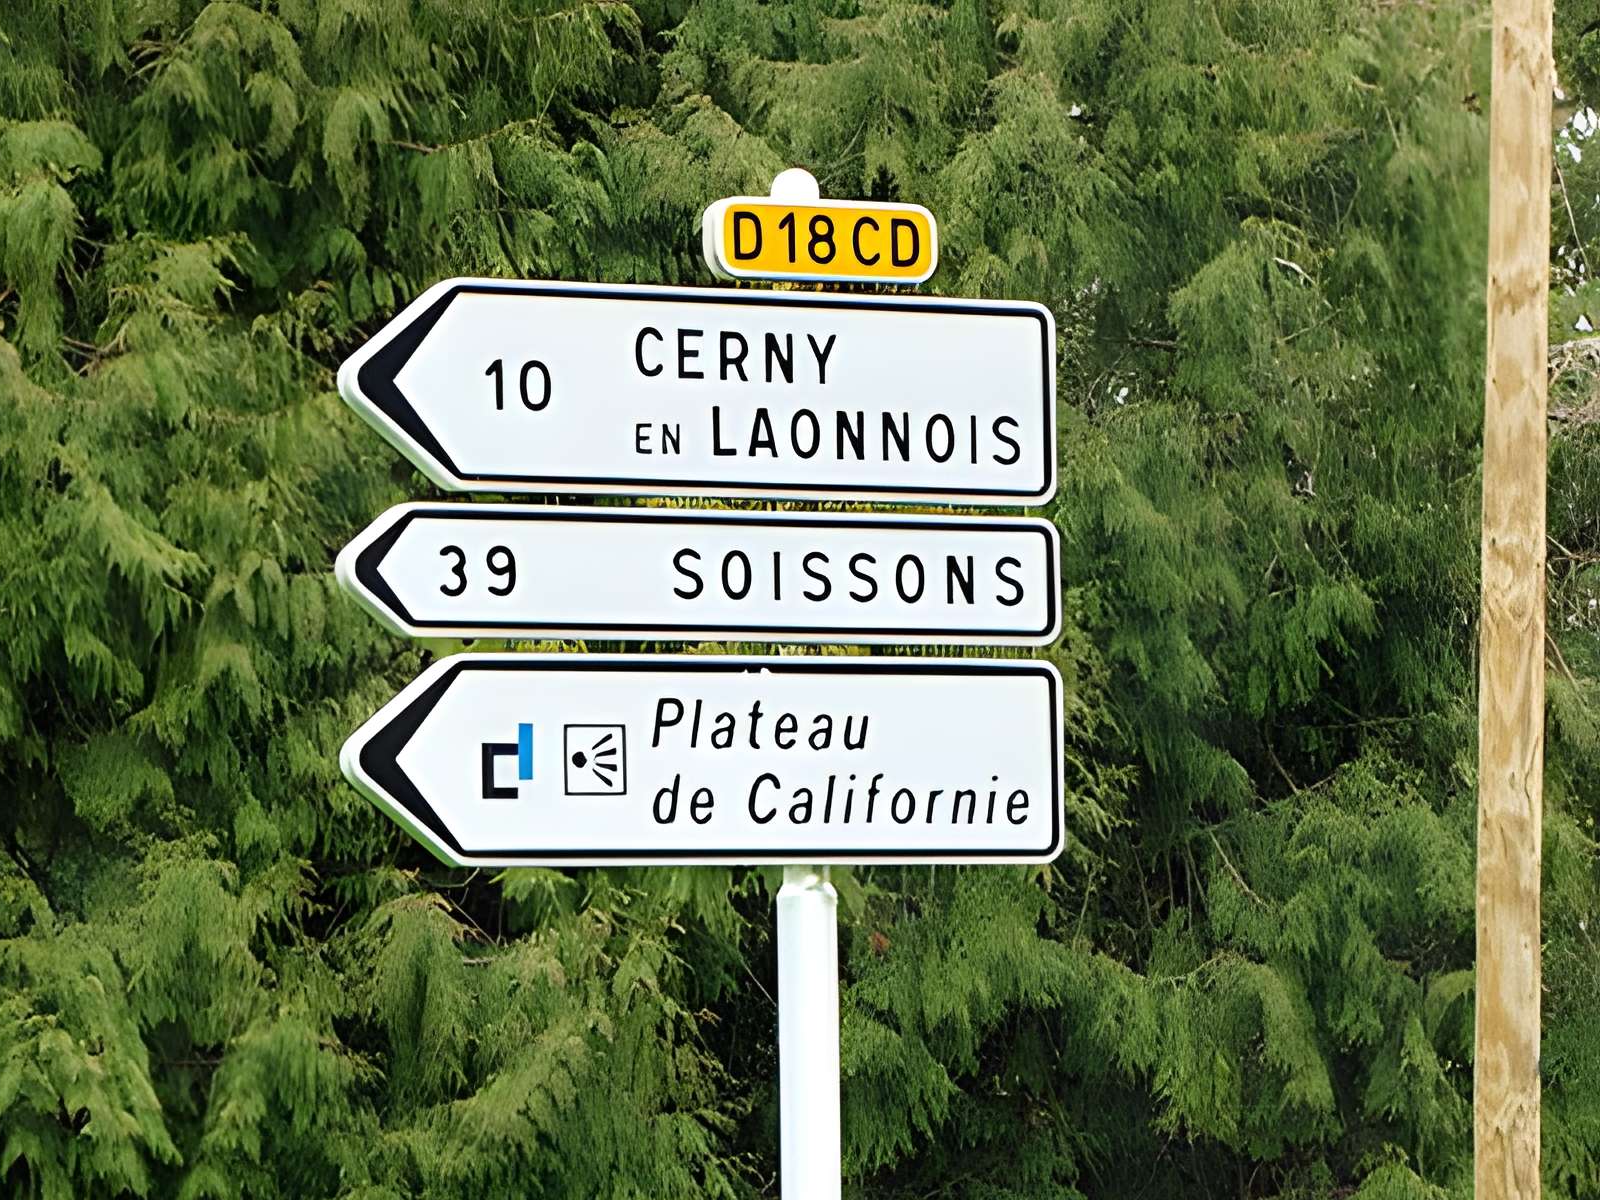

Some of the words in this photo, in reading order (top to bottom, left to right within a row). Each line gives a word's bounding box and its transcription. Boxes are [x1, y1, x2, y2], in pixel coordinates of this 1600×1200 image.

[635, 326, 837, 385] CERNY
[485, 358, 552, 412] 10
[635, 423, 681, 455] EN
[712, 405, 1022, 466] LAONNOIS
[439, 544, 517, 597] 39
[672, 547, 1024, 607] SOISSONS
[651, 697, 869, 751] Plateau
[652, 773, 715, 825] de
[748, 772, 1030, 825] Californie
